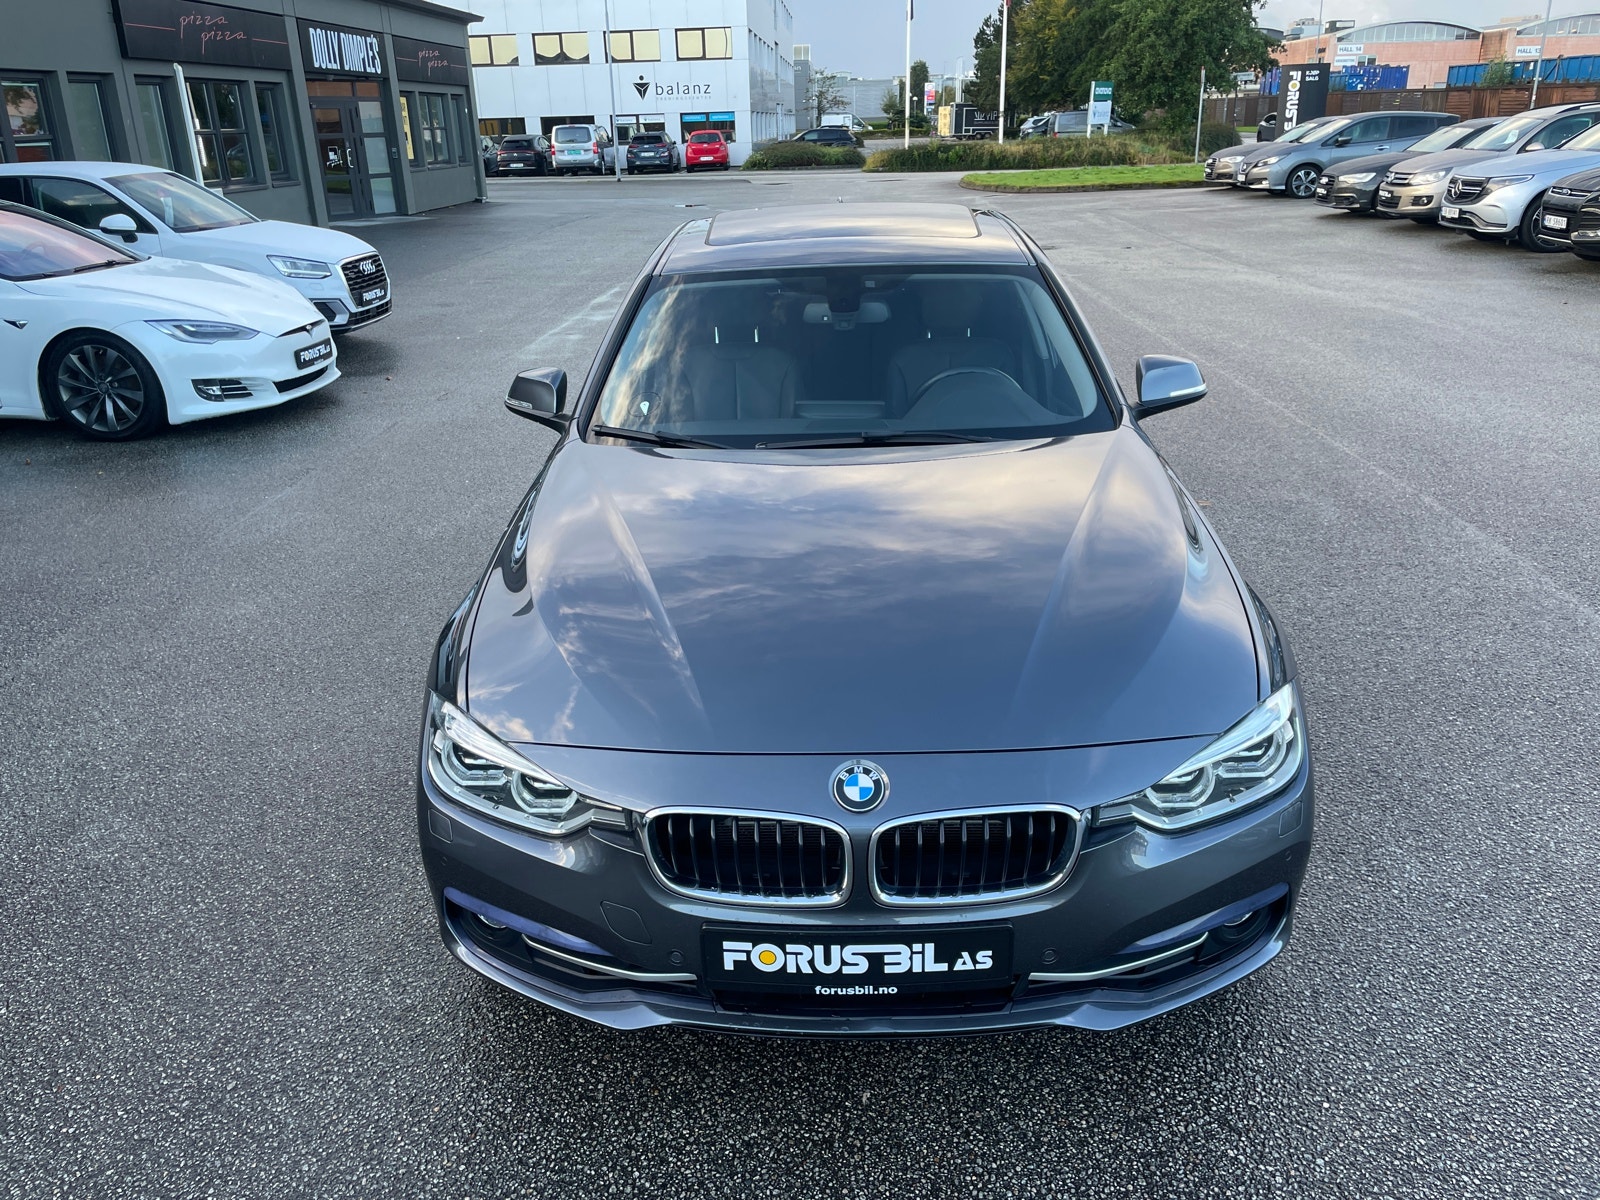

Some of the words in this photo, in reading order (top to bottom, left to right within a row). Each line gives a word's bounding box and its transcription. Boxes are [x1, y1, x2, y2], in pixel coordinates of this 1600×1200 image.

[179, 11, 228, 39] pizza
[201, 27, 247, 54] pizza
[309, 27, 340, 70] DOLLY
[418, 47, 440, 67] pizza
[428, 57, 448, 76] pizza
[655, 82, 711, 95] balanz
[1285, 71, 1301, 127] FORUS
[840, 765, 880, 781] BMW
[722, 941, 870, 974] FORUS
[952, 950, 993, 971] AS
[814, 985, 898, 995] forusbil.no
